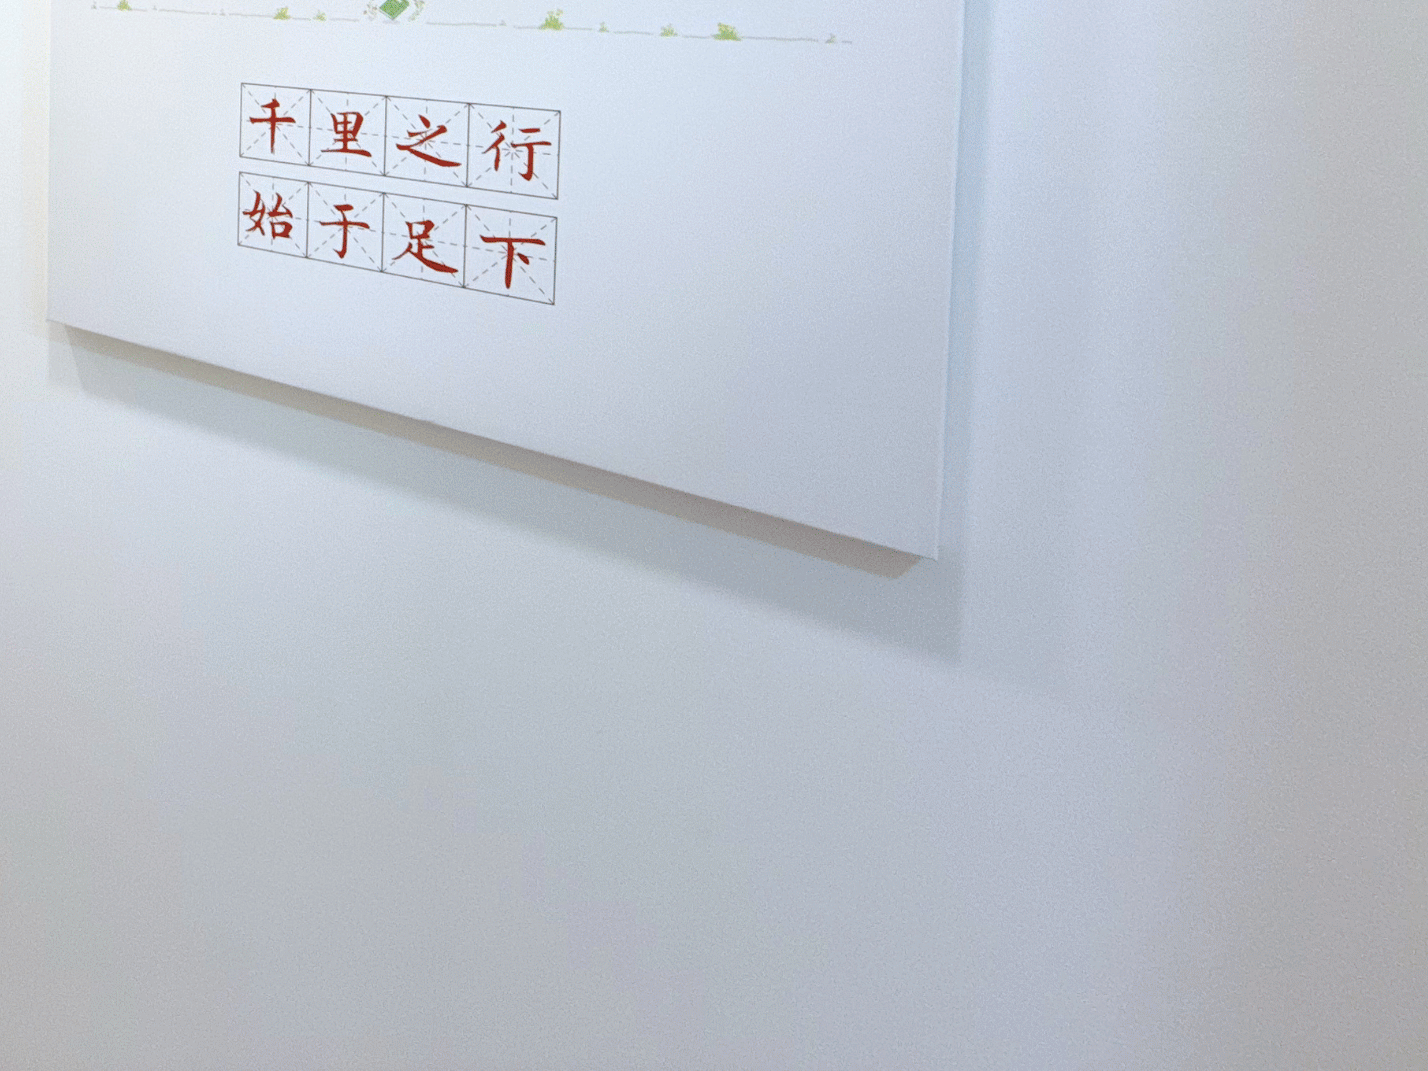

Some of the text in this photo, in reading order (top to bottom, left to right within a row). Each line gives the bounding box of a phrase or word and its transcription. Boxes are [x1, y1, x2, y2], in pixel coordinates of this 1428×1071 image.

[249, 98, 552, 182] 千里之行
[242, 190, 546, 289] 始于足下
